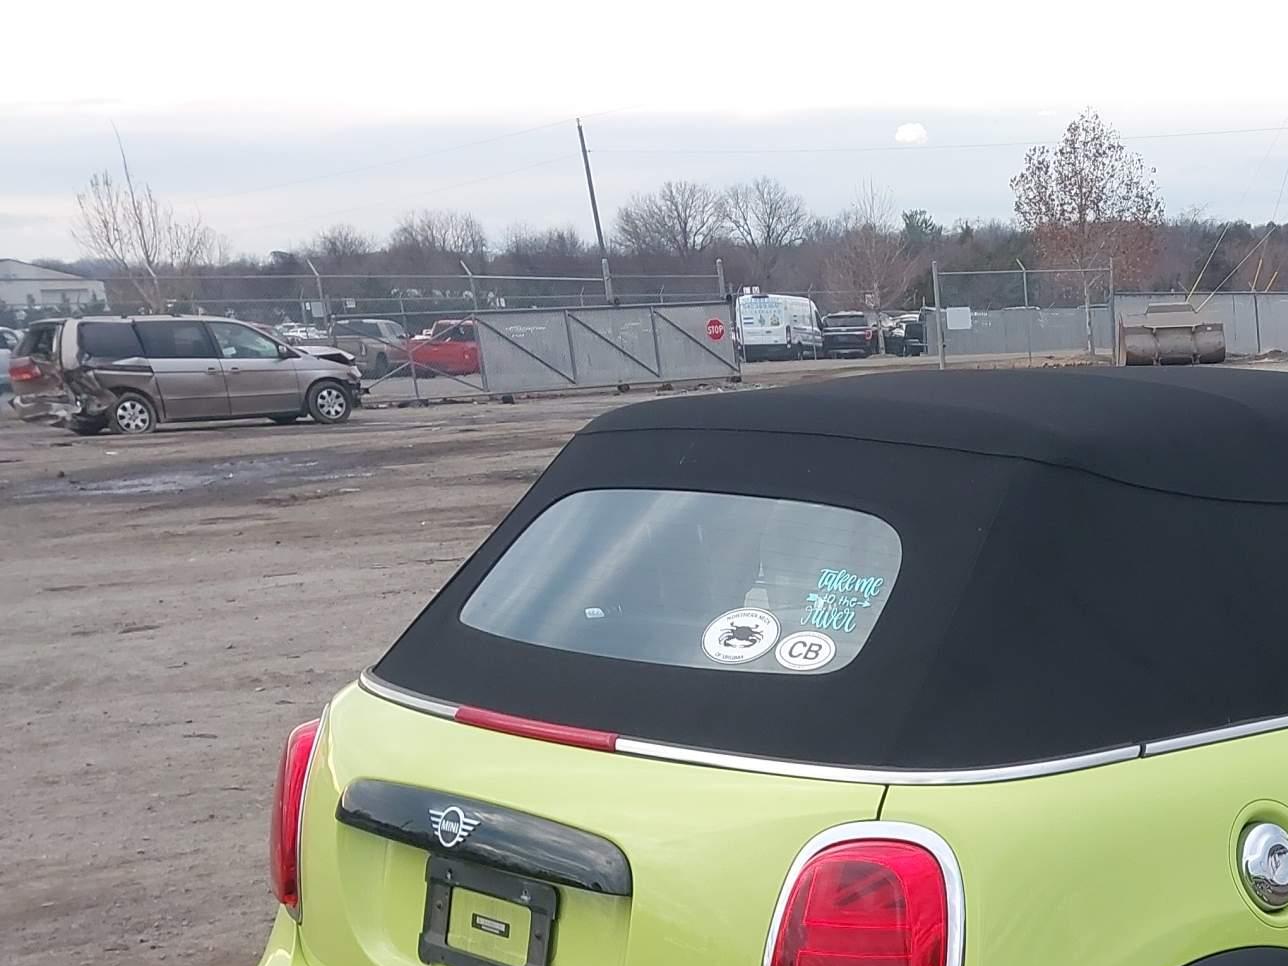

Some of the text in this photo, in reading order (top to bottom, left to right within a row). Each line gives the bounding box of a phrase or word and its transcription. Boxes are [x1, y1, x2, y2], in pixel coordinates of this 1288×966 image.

[707, 325, 724, 335] STOP
[838, 596, 858, 608] the
[788, 640, 823, 660] CB
[441, 819, 459, 834] MINI
